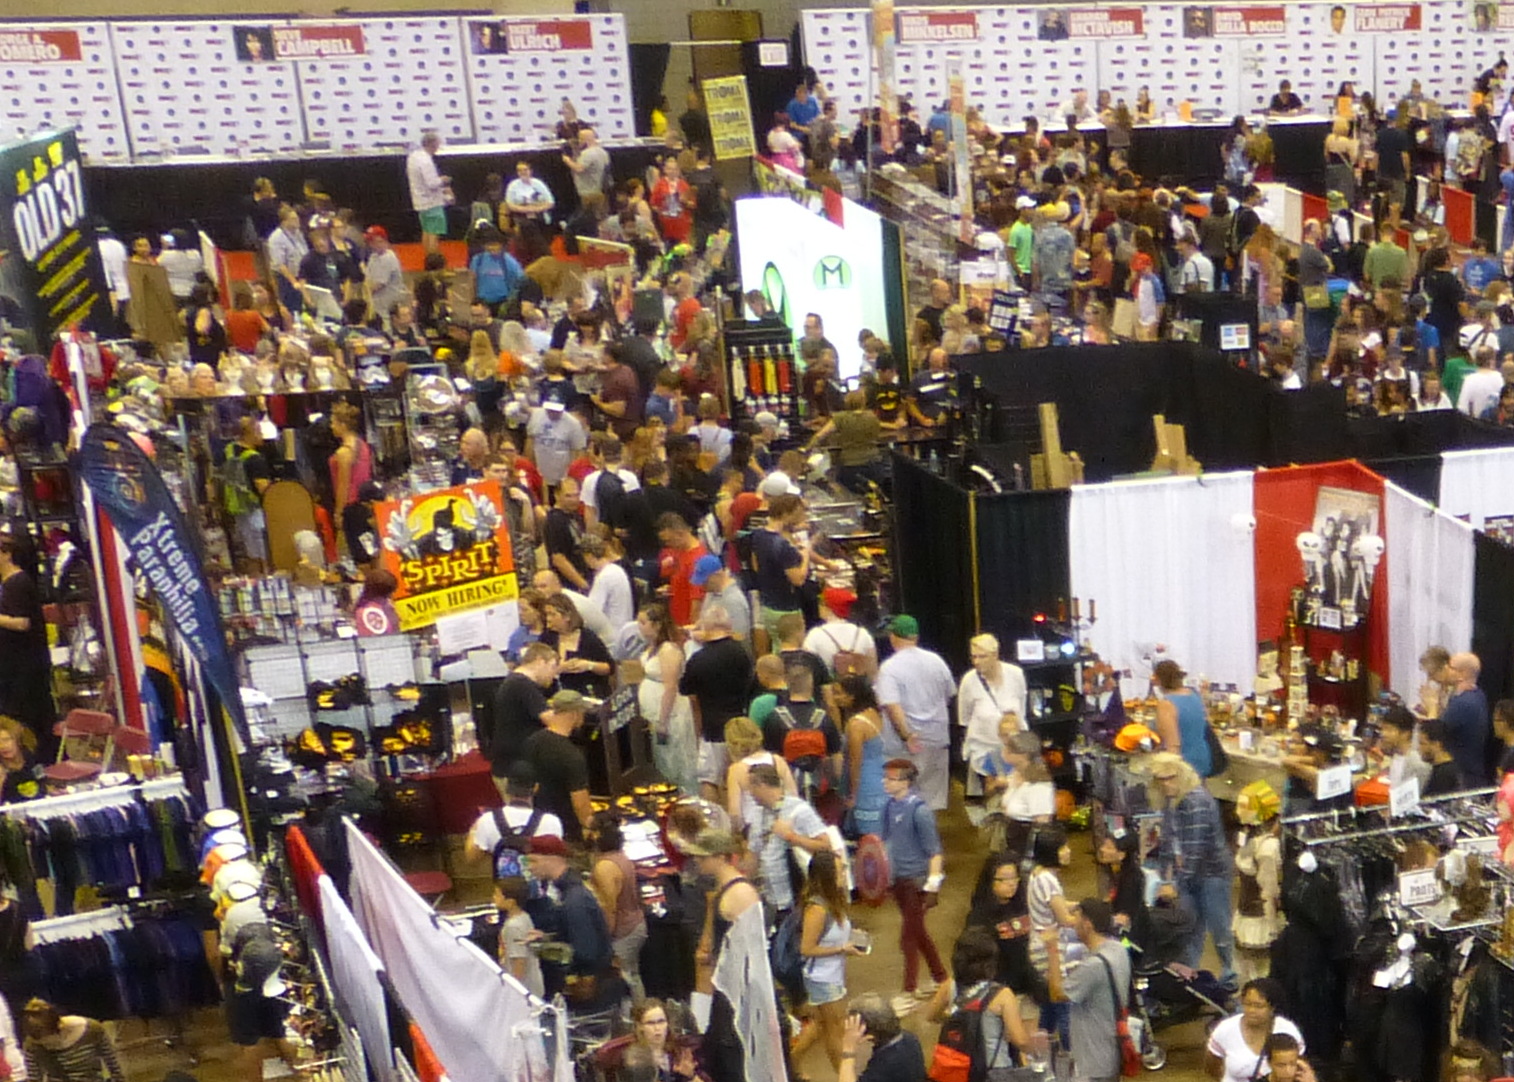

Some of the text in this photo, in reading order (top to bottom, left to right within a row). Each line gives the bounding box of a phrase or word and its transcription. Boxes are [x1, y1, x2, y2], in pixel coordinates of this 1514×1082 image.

[0, 43, 61, 61] OMERO
[276, 38, 356, 55] CAMPBELL
[14, 182, 61, 262] OLD
[54, 158, 85, 228] 37
[151, 511, 200, 595] Xtreme
[404, 541, 494, 586] SPIRIT
[405, 596, 441, 615] NOW
